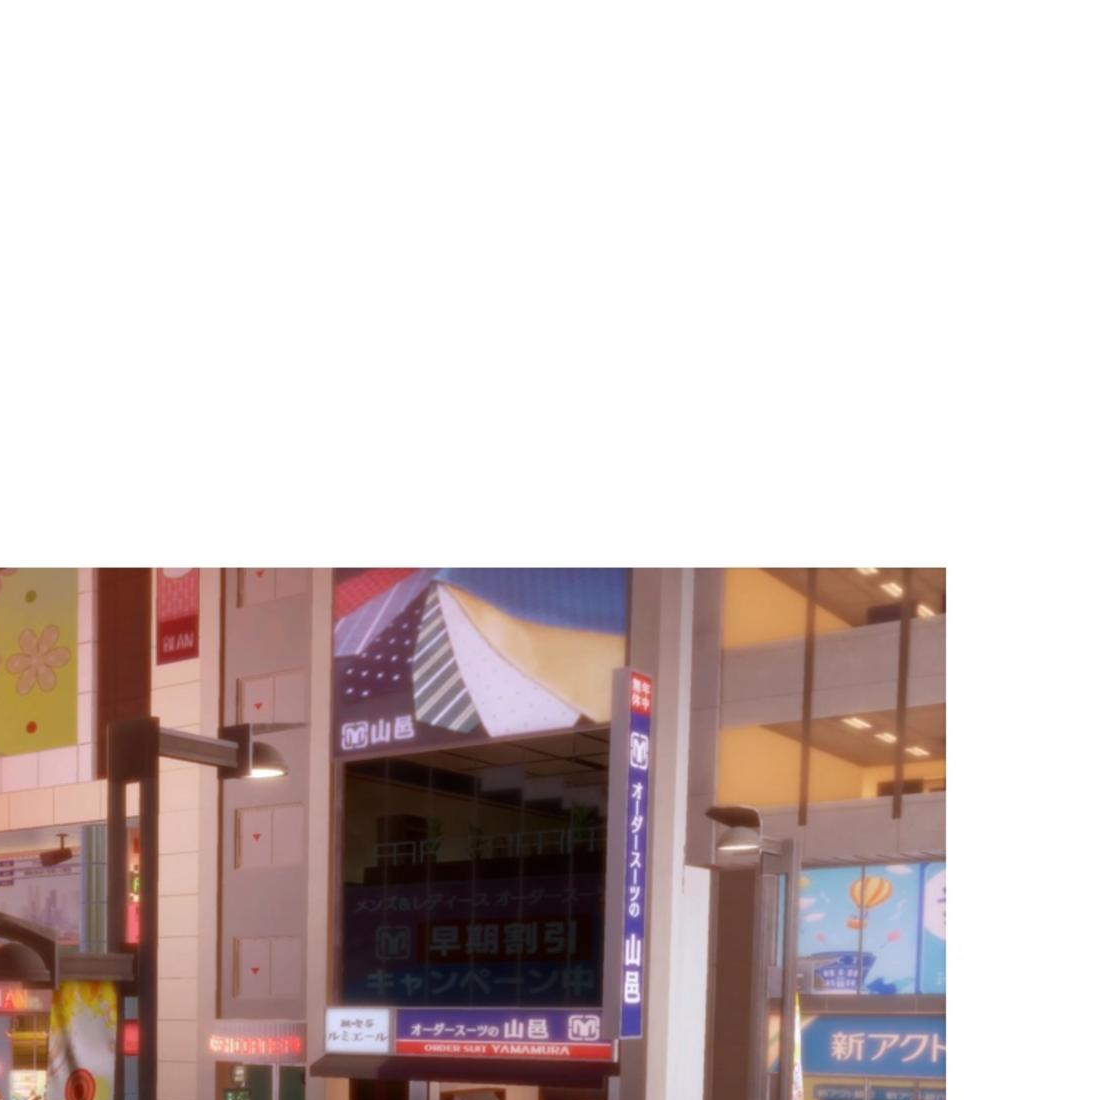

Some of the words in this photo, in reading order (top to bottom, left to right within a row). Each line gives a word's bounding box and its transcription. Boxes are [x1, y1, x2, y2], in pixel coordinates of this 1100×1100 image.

[163, 633, 194, 653] BLAN
[628, 782, 644, 918] オーダースーツの
[428, 920, 579, 957] 早期割引
[366, 965, 596, 997] キャンペーン中
[327, 1031, 388, 1041] ルミエール
[410, 1023, 499, 1037] オーダースーツの
[424, 1044, 460, 1053] ORDER
[463, 1044, 488, 1054] SUIT
[491, 1044, 571, 1056] YAMAMURA
[831, 1031, 946, 1063] 新アクト
